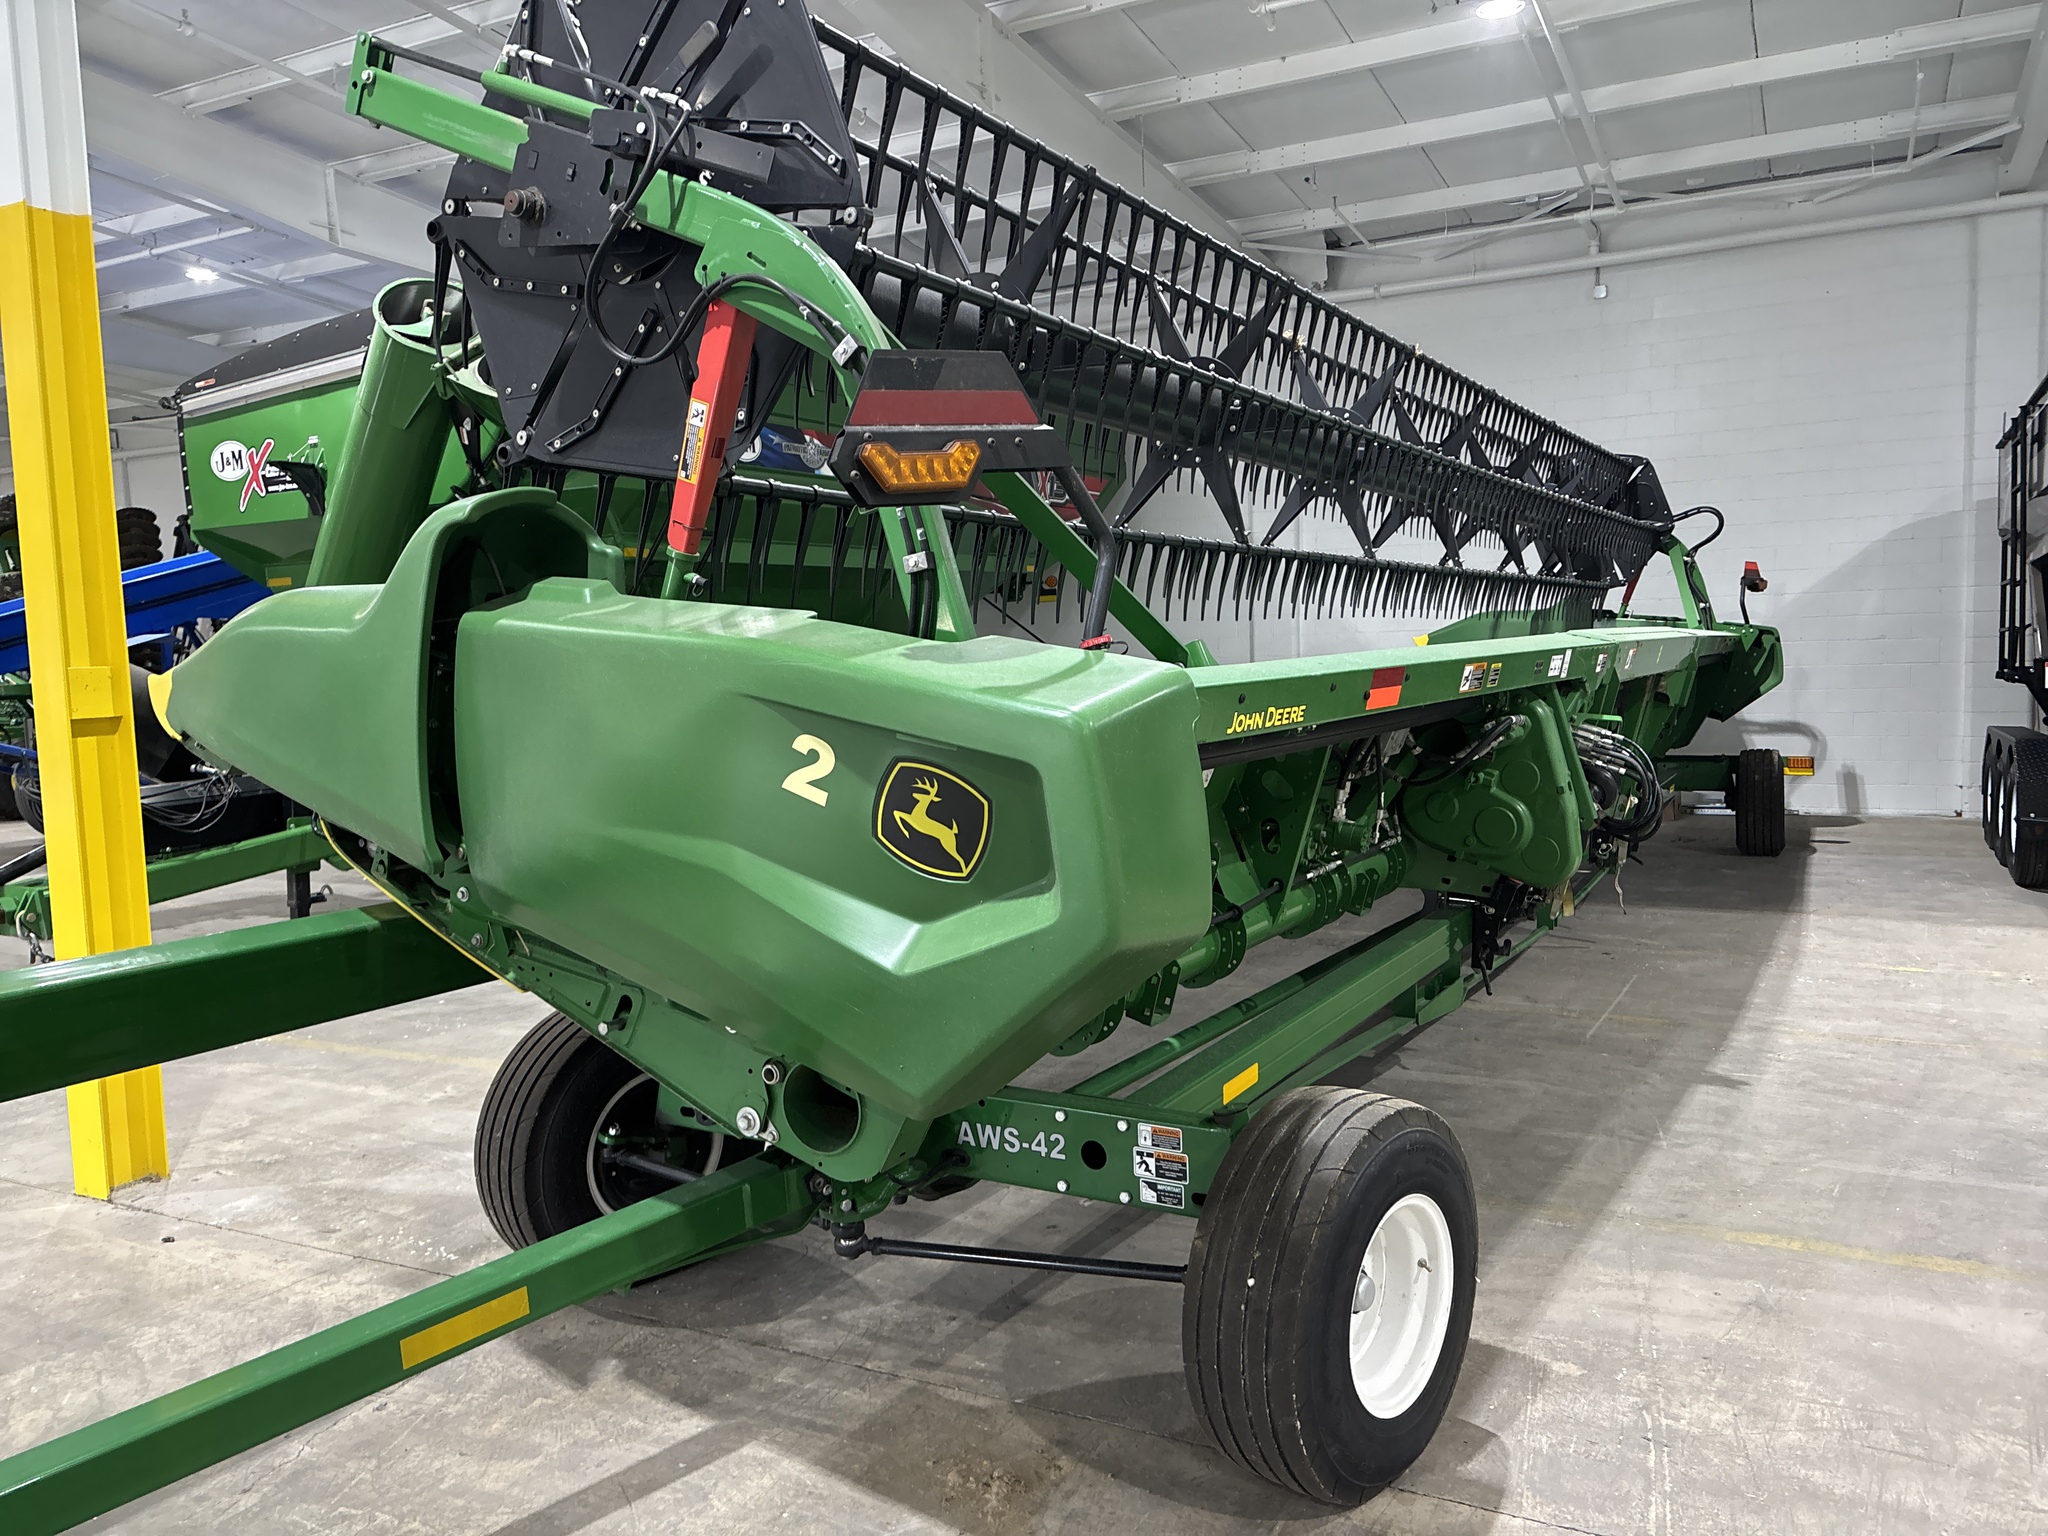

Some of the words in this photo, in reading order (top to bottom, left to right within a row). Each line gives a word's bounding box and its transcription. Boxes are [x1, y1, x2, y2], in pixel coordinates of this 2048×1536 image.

[215, 449, 244, 473] J&M
[693, 446, 702, 475] WARNING
[1226, 711, 1265, 735] JOHN
[1265, 704, 1307, 728] DEERE
[781, 733, 836, 807] 2
[957, 1120, 1067, 1160] AWS-42
[1157, 1128, 1180, 1136] WARNING
[1162, 1153, 1186, 1161] WARNING
[1157, 1184, 1182, 1192] IMPORTANT
